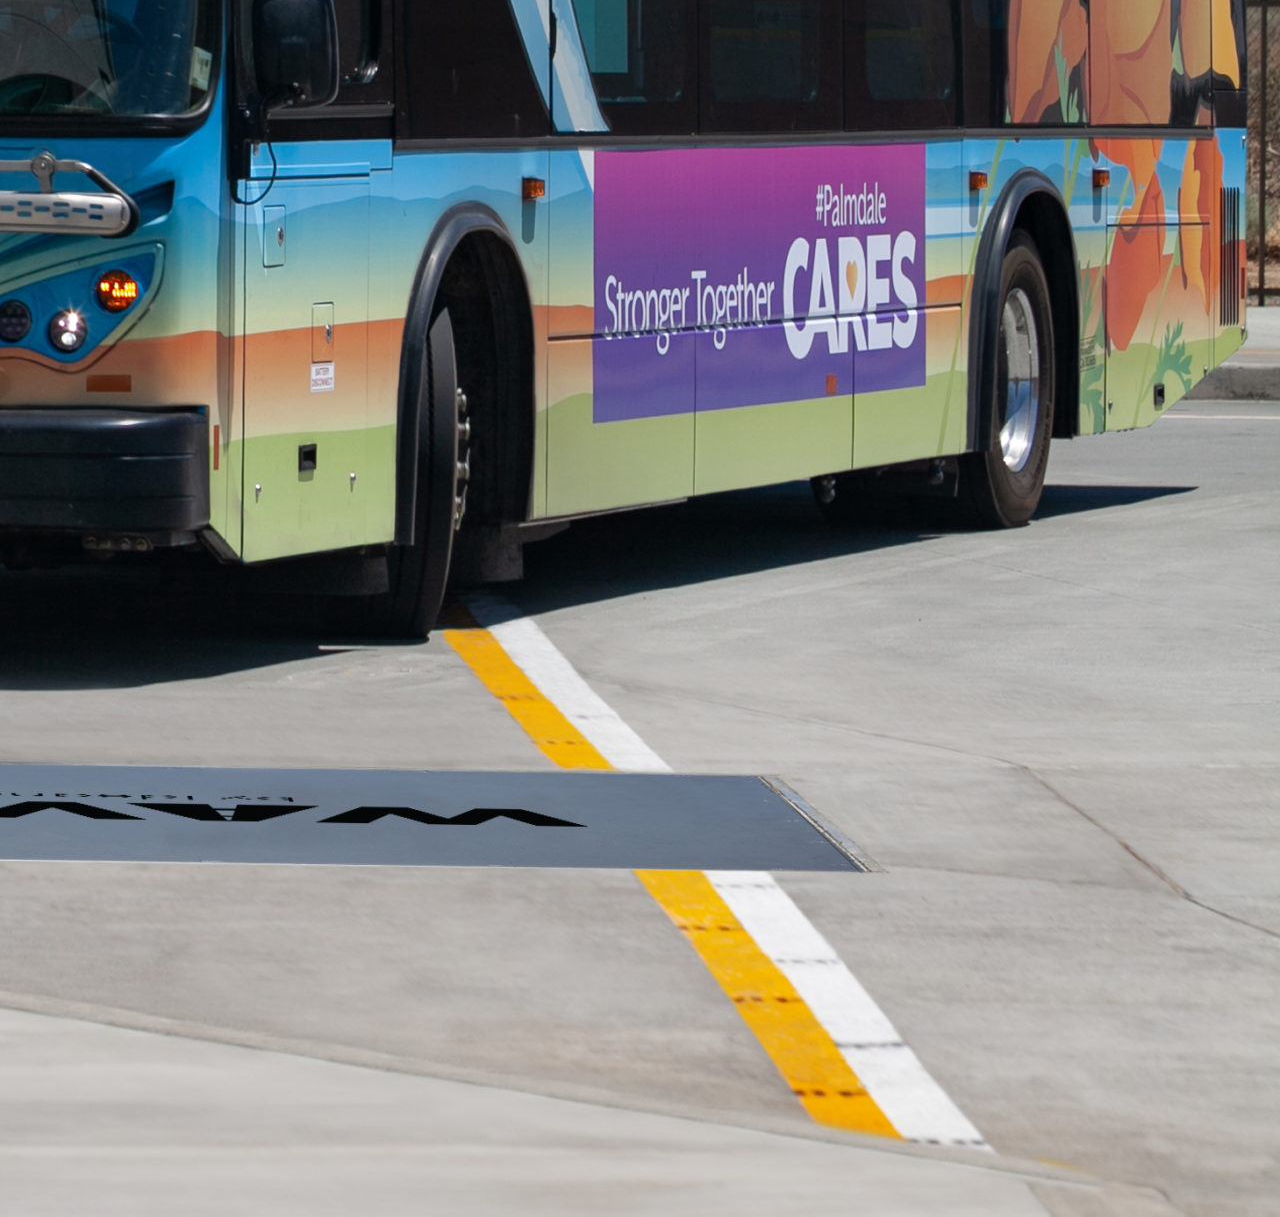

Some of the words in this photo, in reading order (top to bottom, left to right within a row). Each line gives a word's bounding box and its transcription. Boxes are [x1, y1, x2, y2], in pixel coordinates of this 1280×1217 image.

[815, 182, 887, 227] #Palmdale
[605, 275, 690, 355] Stronger
[691, 267, 775, 350] Together
[783, 230, 918, 360] CARES
